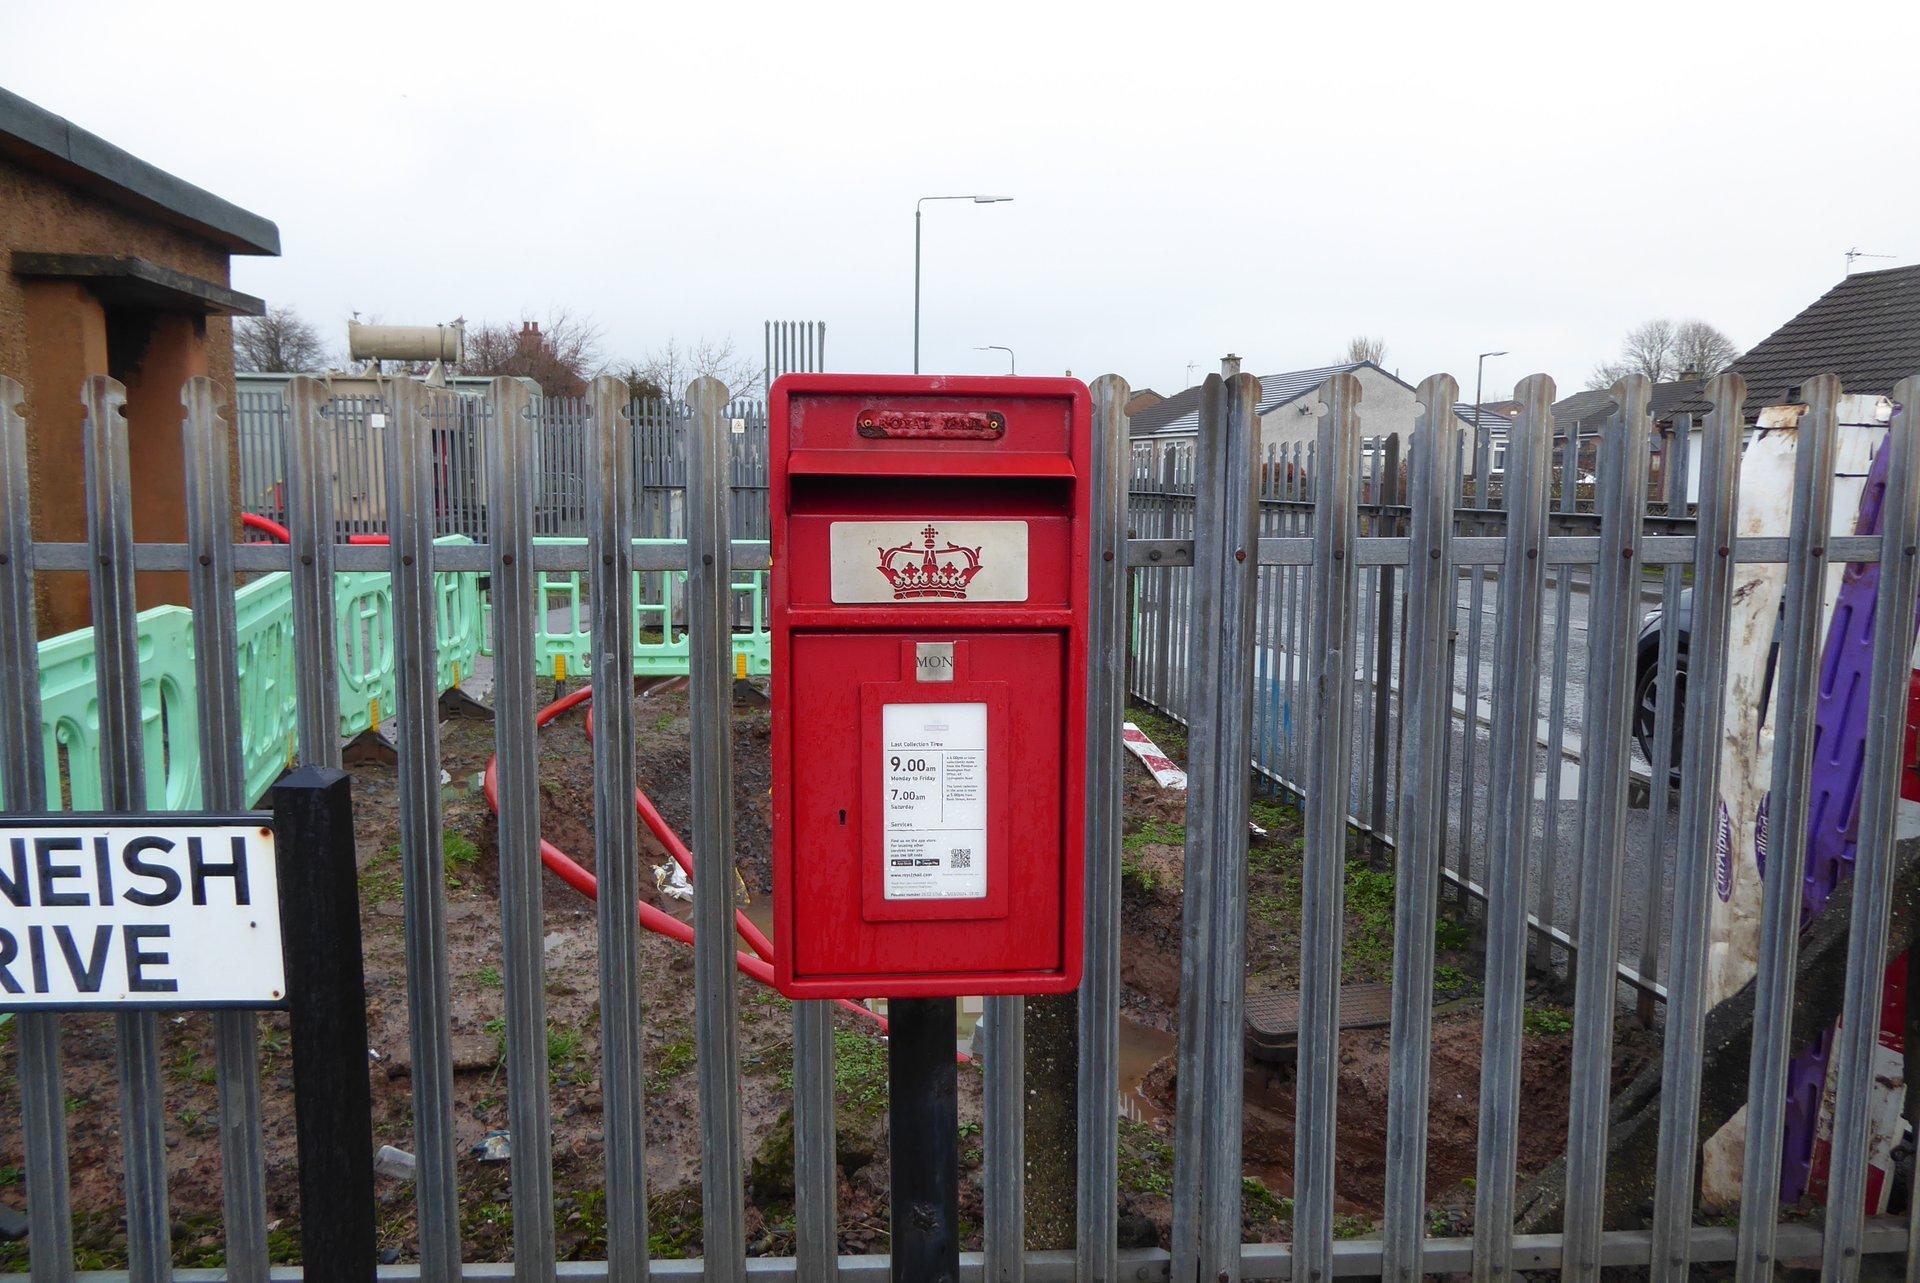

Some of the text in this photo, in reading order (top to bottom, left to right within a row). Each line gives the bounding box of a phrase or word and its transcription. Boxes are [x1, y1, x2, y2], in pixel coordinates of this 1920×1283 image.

[879, 417, 984, 431] ROYAL MAIL
[916, 656, 953, 668] MON
[890, 756, 936, 772] 9.00am
[890, 789, 926, 801] 7.00am
